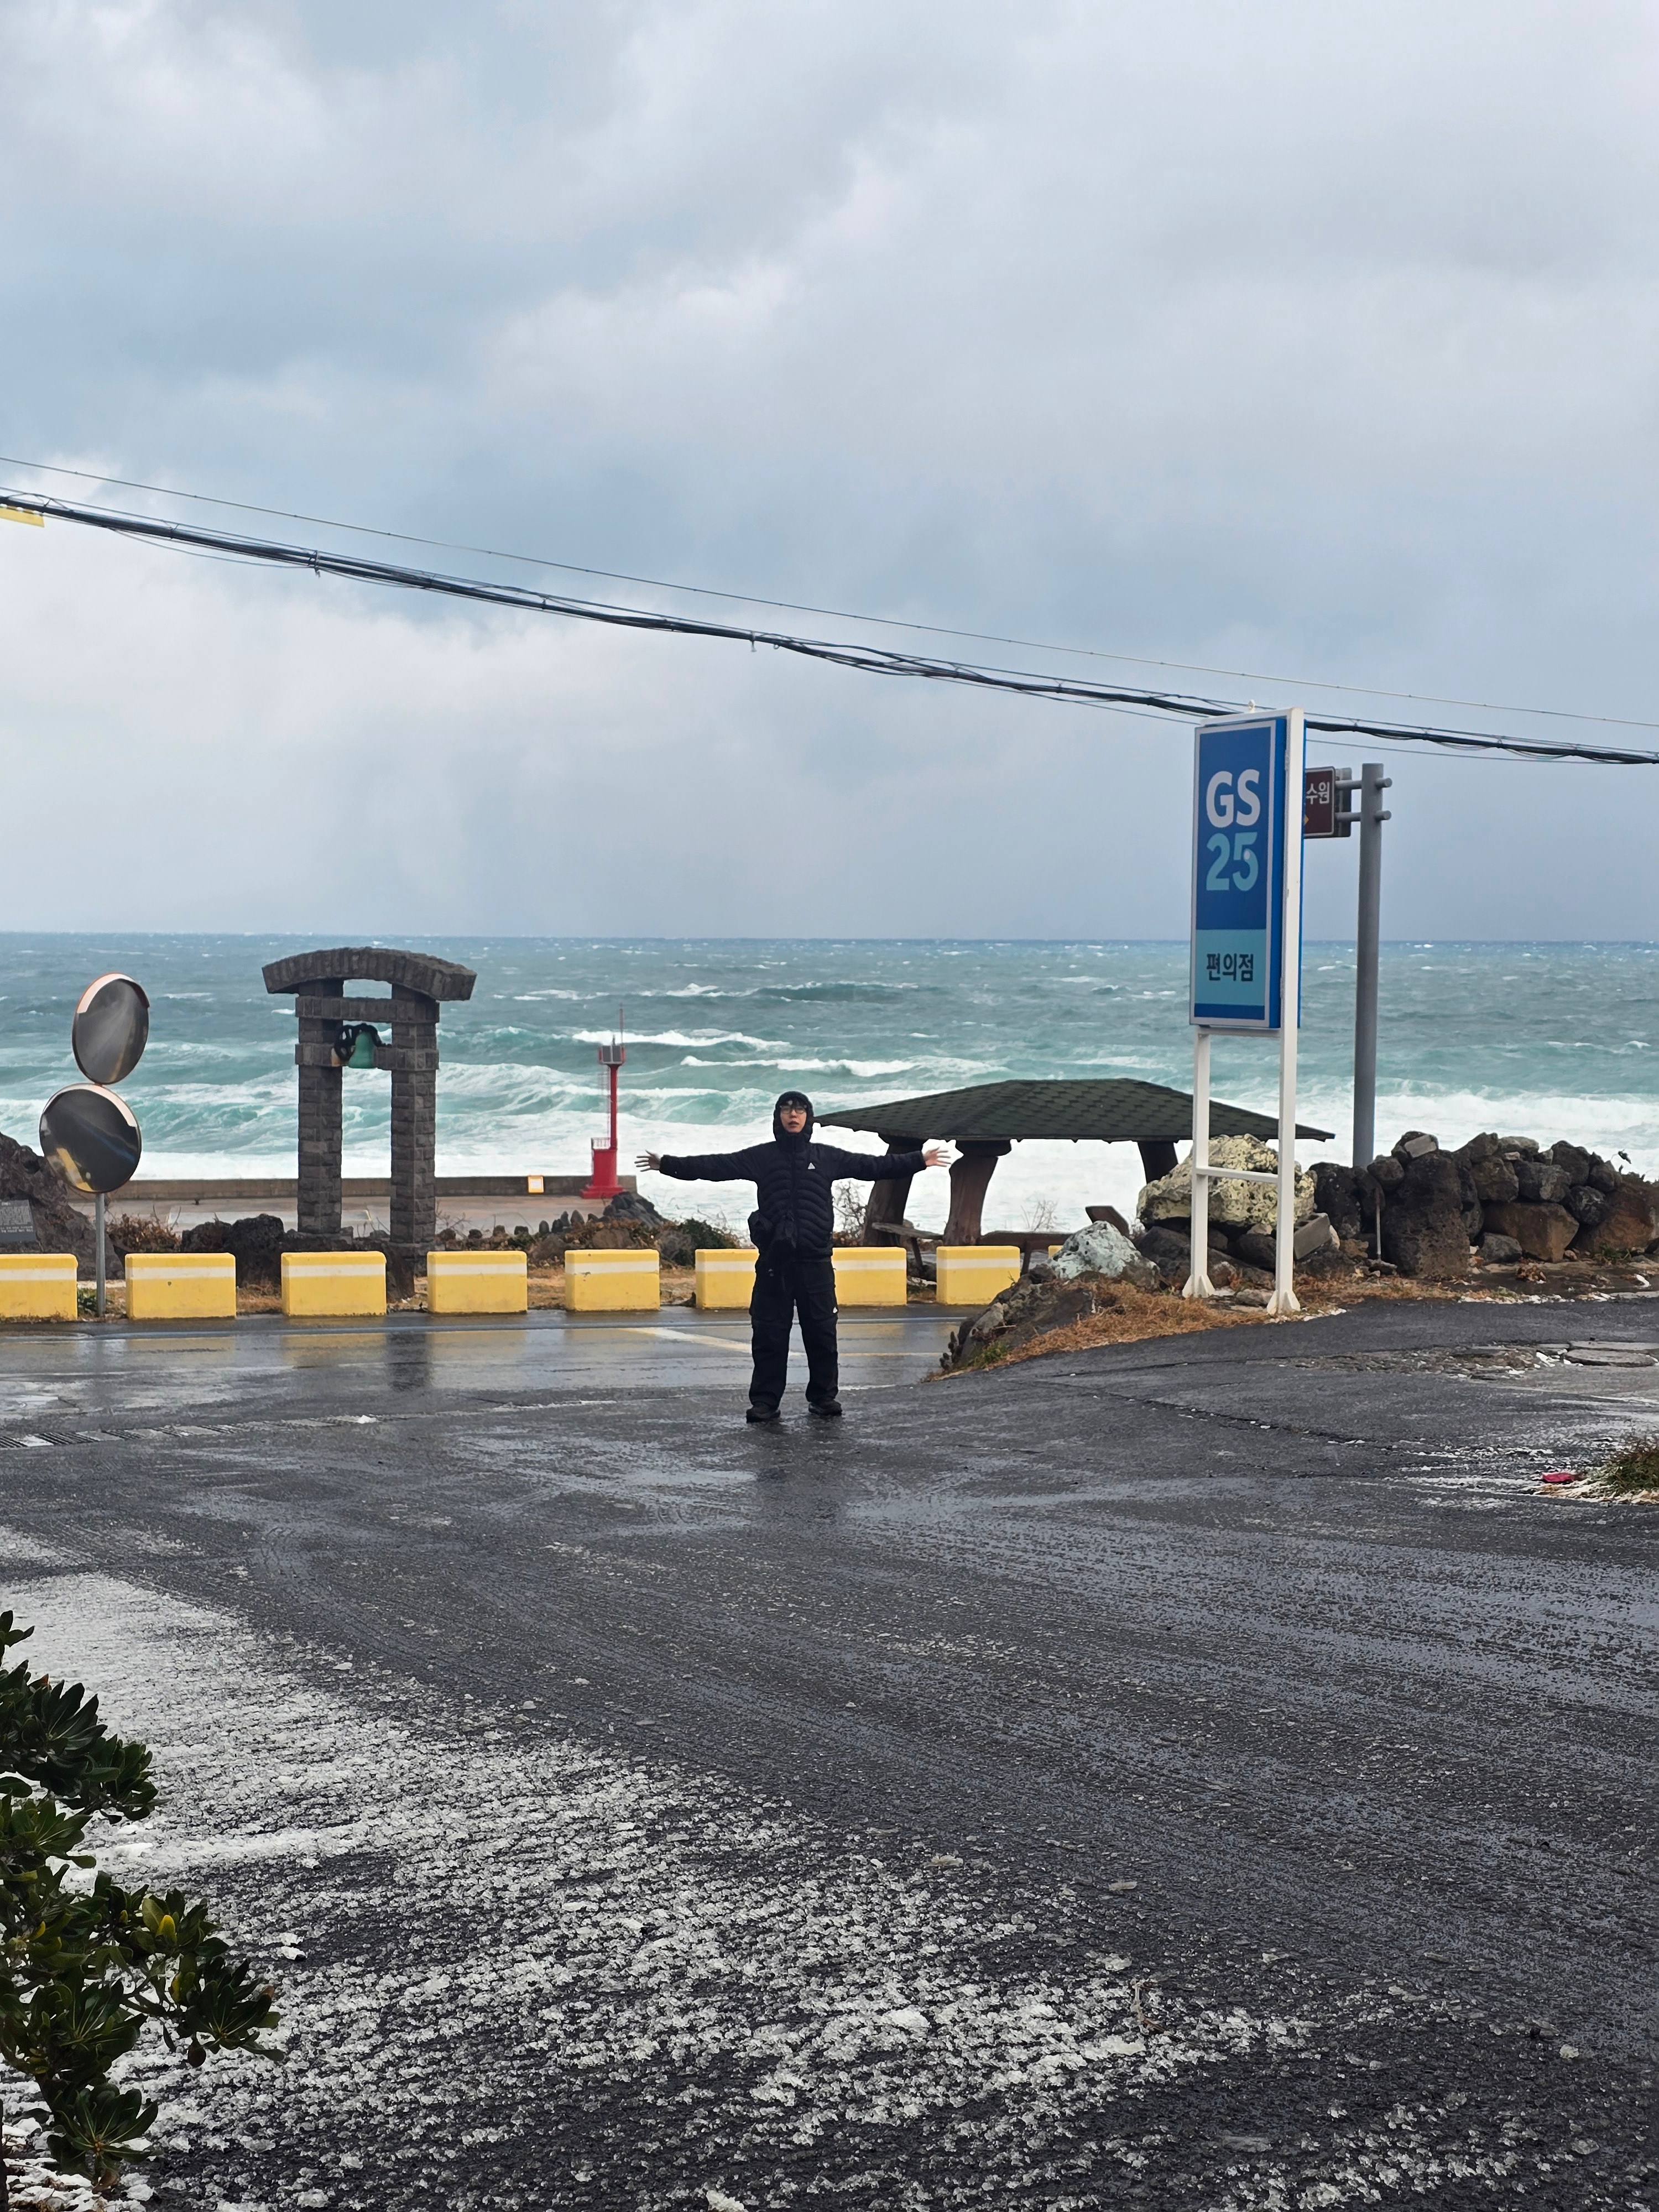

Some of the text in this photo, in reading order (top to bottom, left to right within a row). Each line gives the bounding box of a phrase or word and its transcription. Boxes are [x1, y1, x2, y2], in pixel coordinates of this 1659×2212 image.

[1206, 769, 1260, 828] GS
[1206, 831, 1259, 891] 25
[1206, 953, 1254, 982] 편의점
